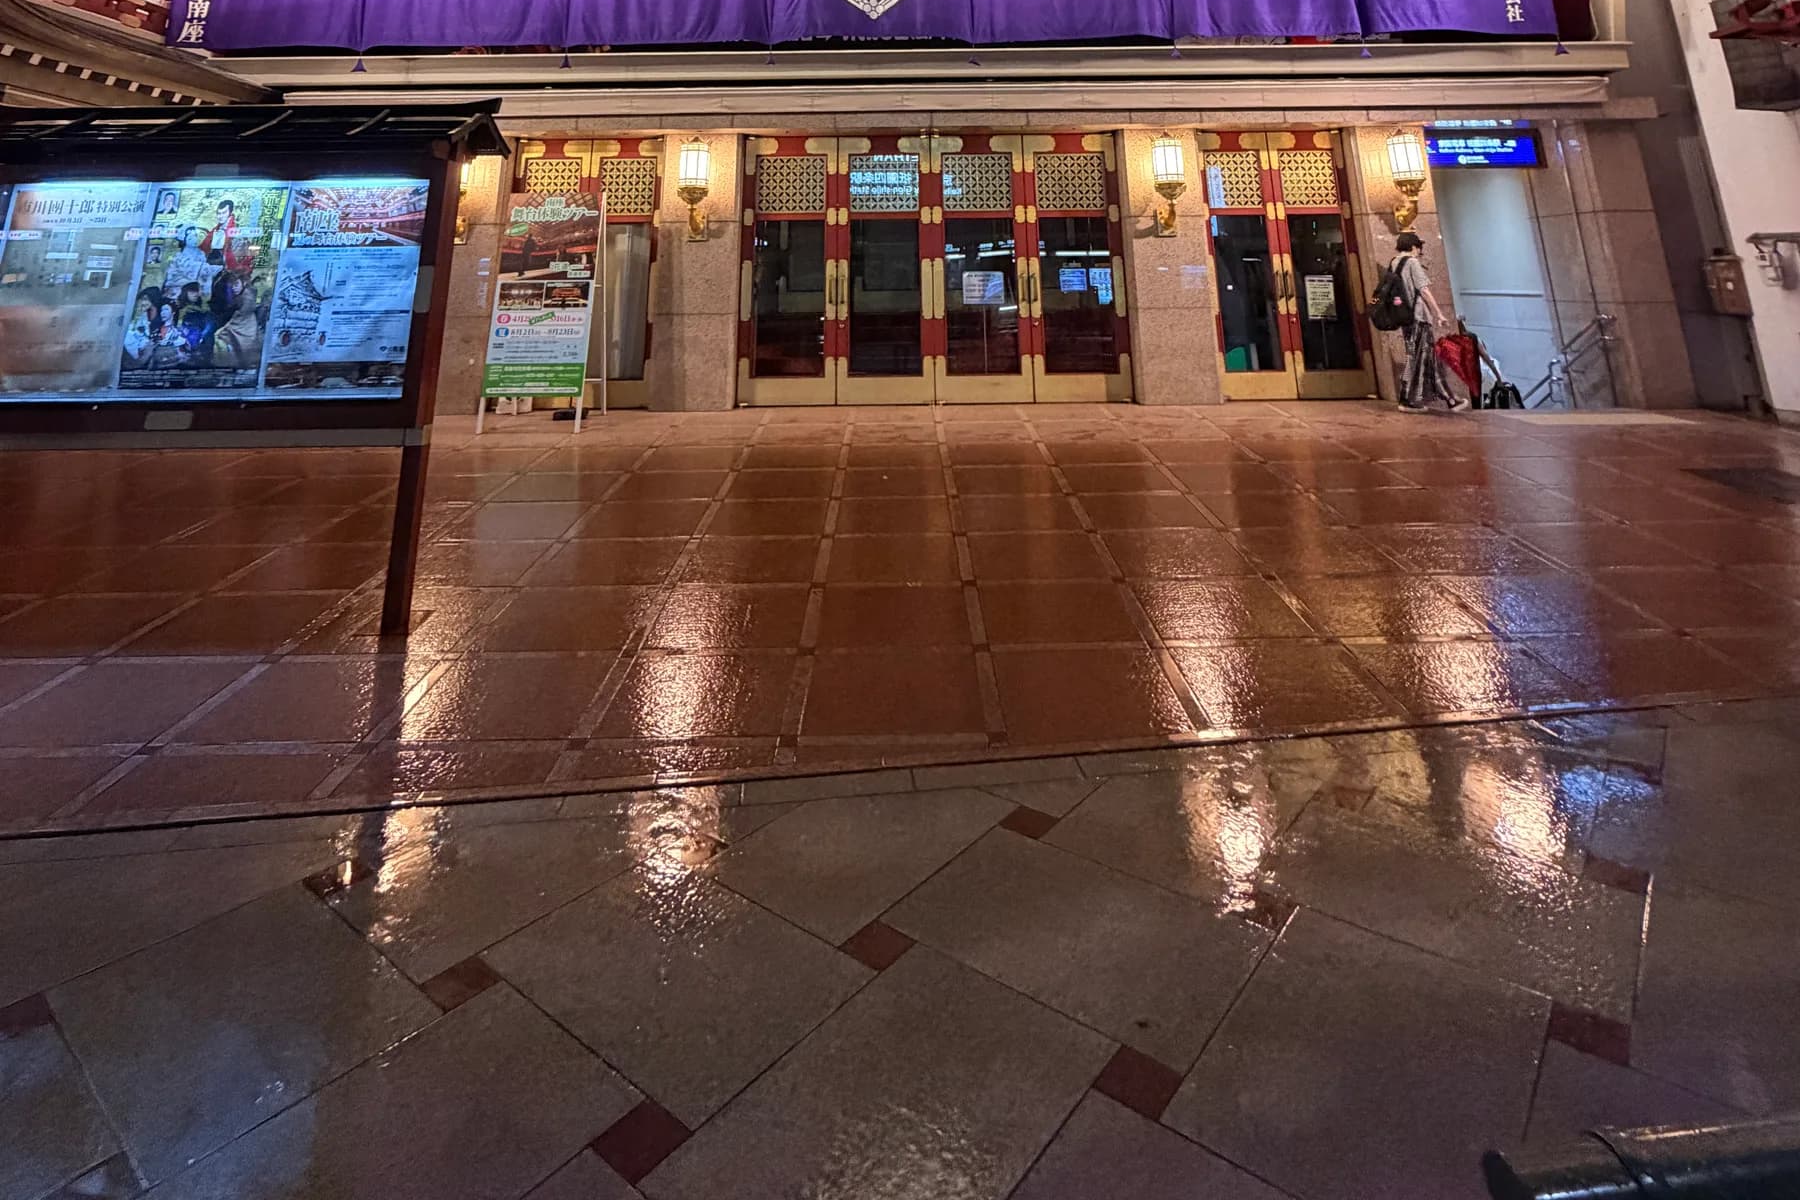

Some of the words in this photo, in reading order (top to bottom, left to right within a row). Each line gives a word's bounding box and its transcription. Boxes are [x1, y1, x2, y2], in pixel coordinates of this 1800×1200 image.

[295, 209, 340, 233] 南座
[511, 205, 599, 221] 舞台体験ツアー
